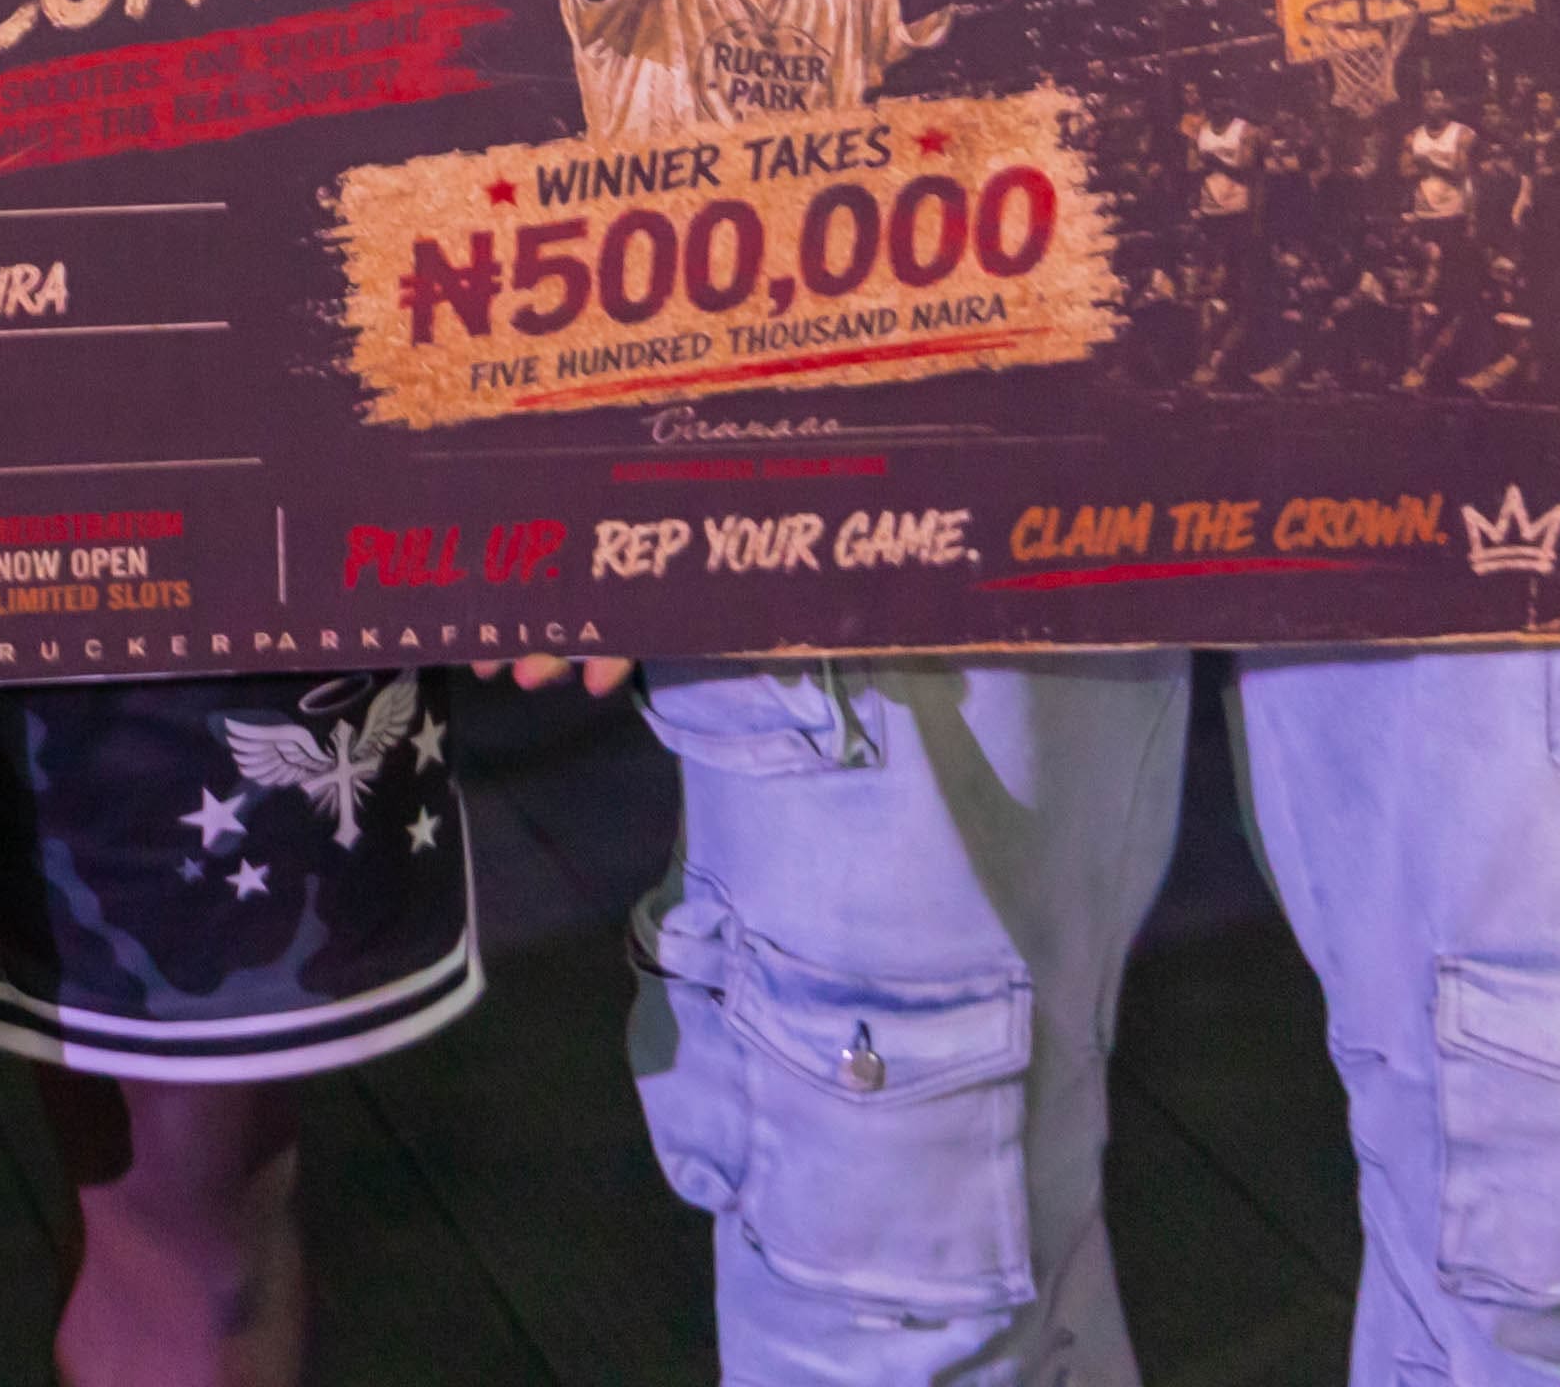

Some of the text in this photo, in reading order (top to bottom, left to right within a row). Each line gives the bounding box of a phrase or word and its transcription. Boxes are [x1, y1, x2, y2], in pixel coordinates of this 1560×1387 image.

[713, 42, 826, 83] RUCKER
[730, 77, 809, 115] PARK
[536, 125, 894, 209] WINNER TAKES
[470, 294, 1009, 393] FIVE HUNDRED THOUSAND NAIRA
[70, 546, 148, 578] OPEN
[345, 523, 469, 591] PULL
[592, 519, 690, 582] REP
[705, 511, 826, 573] YOUR
[835, 508, 981, 569] GAME.
[1010, 502, 1153, 563] CLAIM
[1169, 499, 1261, 552] THE
[1274, 494, 1449, 549] CROWN.
[107, 579, 192, 612] SLOTS
